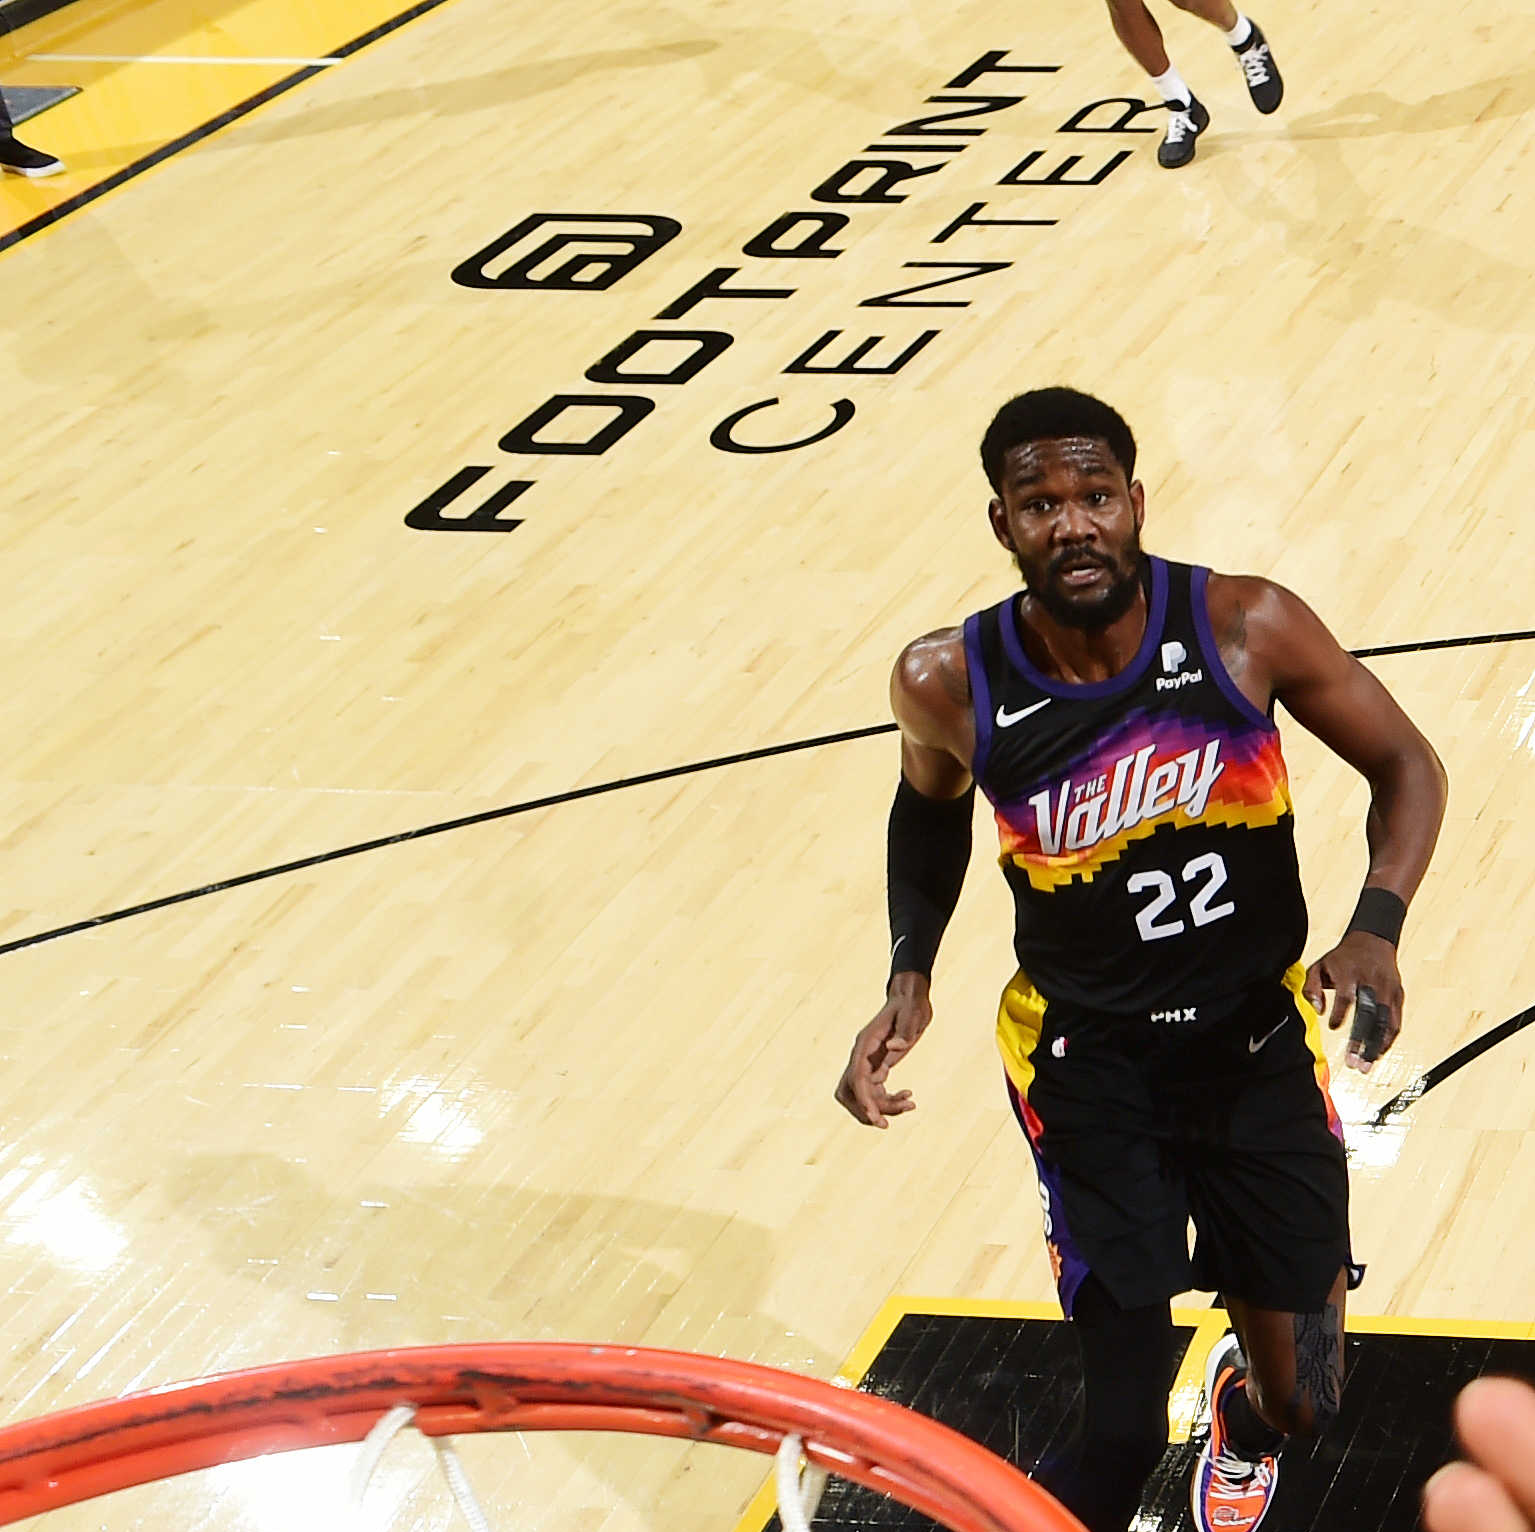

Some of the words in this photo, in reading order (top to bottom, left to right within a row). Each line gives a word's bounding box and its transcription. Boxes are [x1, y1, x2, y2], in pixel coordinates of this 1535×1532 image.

[404, 49, 1063, 533] FOOTPRINT
[709, 97, 1186, 454] CENTER
[1155, 668, 1203, 692] PayPal
[1028, 738, 1225, 855] Valley
[1074, 774, 1107, 803] THE
[1126, 851, 1235, 942] 22
